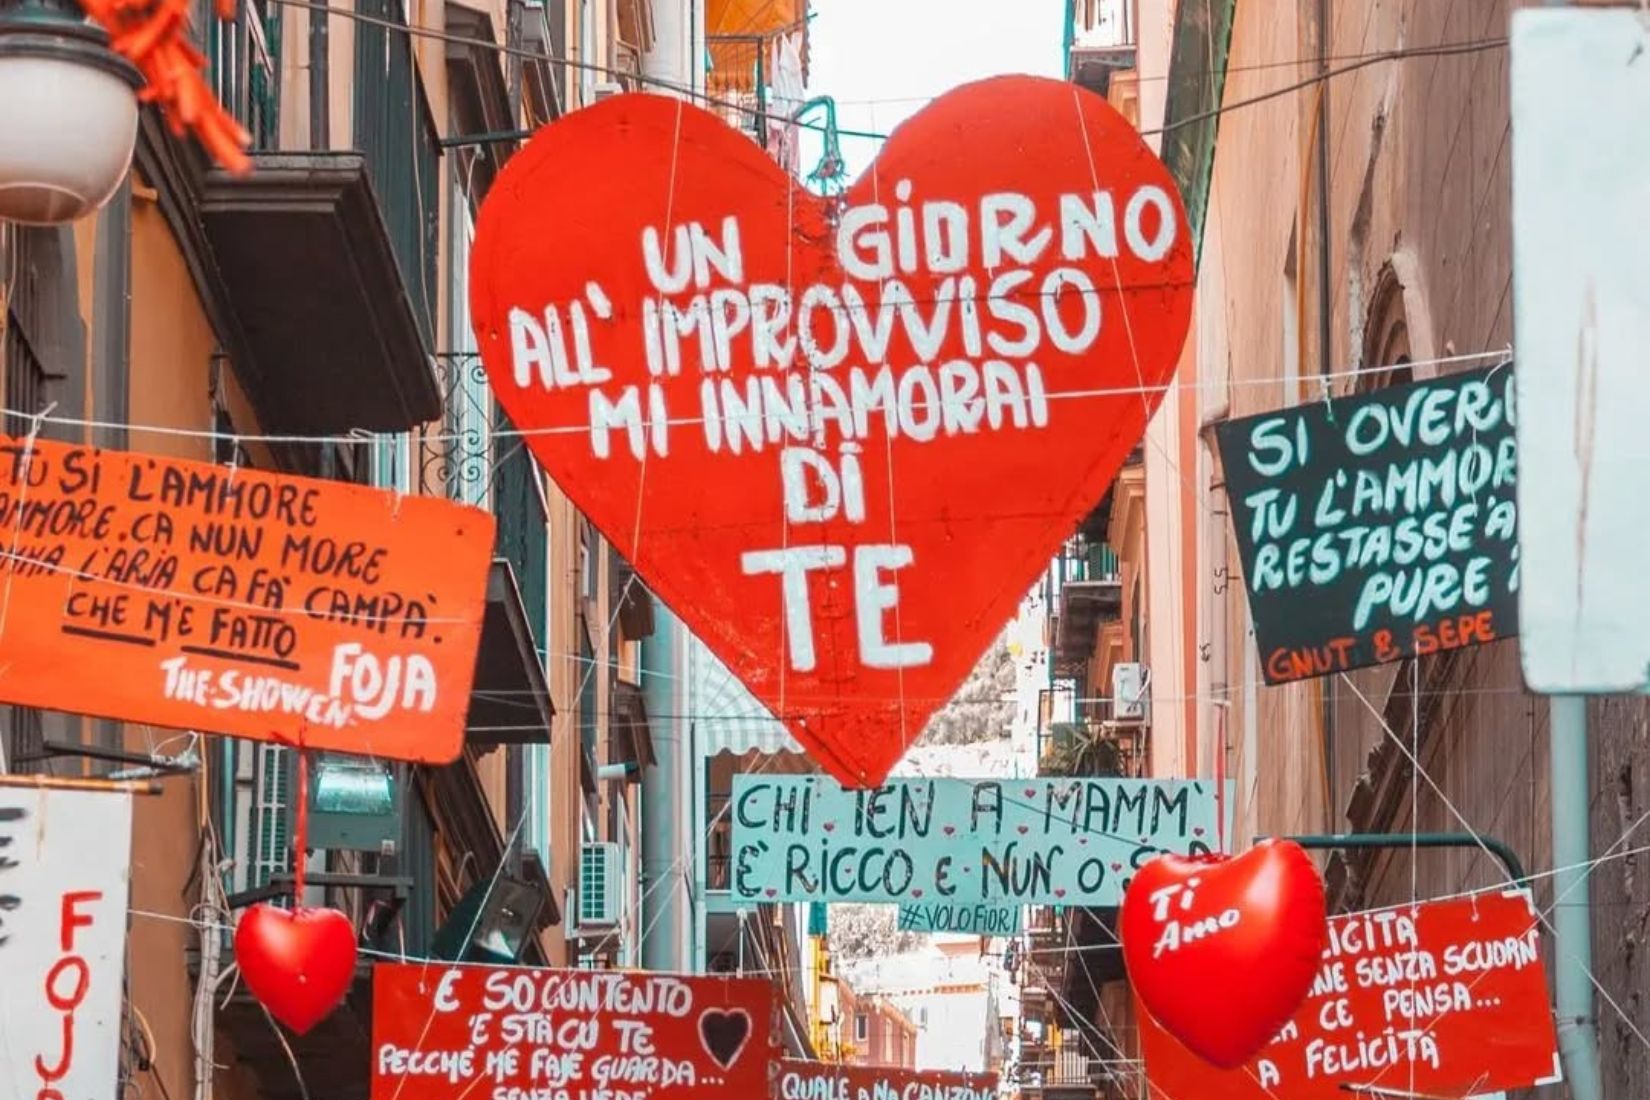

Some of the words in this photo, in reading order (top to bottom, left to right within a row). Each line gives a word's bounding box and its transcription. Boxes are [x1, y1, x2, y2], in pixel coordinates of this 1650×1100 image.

[641, 215, 742, 294] UN
[509, 282, 613, 390] ALL'
[643, 267, 1100, 375] IMPROVVISO
[589, 384, 668, 460] MI
[702, 361, 1048, 453] INNAMORAI
[1248, 416, 1308, 477] SI
[0, 446, 48, 487] TU
[59, 450, 101, 494] SI
[128, 461, 320, 526] L'AMMORE
[782, 441, 865, 523] DI
[1245, 489, 1296, 543] TU
[1253, 503, 1478, 592] RESTASSE
[190, 522, 264, 561] NUN
[282, 536, 388, 585] MORE
[193, 564, 237, 598] CA
[67, 591, 127, 626] CHE
[210, 612, 296, 657] FATTO
[743, 546, 929, 670] TE
[1353, 557, 1492, 631] PURE
[1267, 638, 1355, 680] GNUT
[1414, 611, 1495, 654] SEPE
[330, 643, 437, 720] FOJA
[737, 777, 815, 833] CHI
[970, 783, 1003, 833] A
[785, 839, 914, 896] RICCO
[934, 857, 957, 896] E
[1077, 857, 1103, 895] O
[434, 970, 462, 1011] E
[541, 974, 693, 1017] CUNTENTO
[1355, 951, 1437, 988] SENZA
[556, 1018, 600, 1050] CU
[612, 1020, 656, 1055] TE
[1318, 998, 1353, 1031] CE
[486, 1048, 520, 1083] ME
[531, 1048, 584, 1088] FAJE
